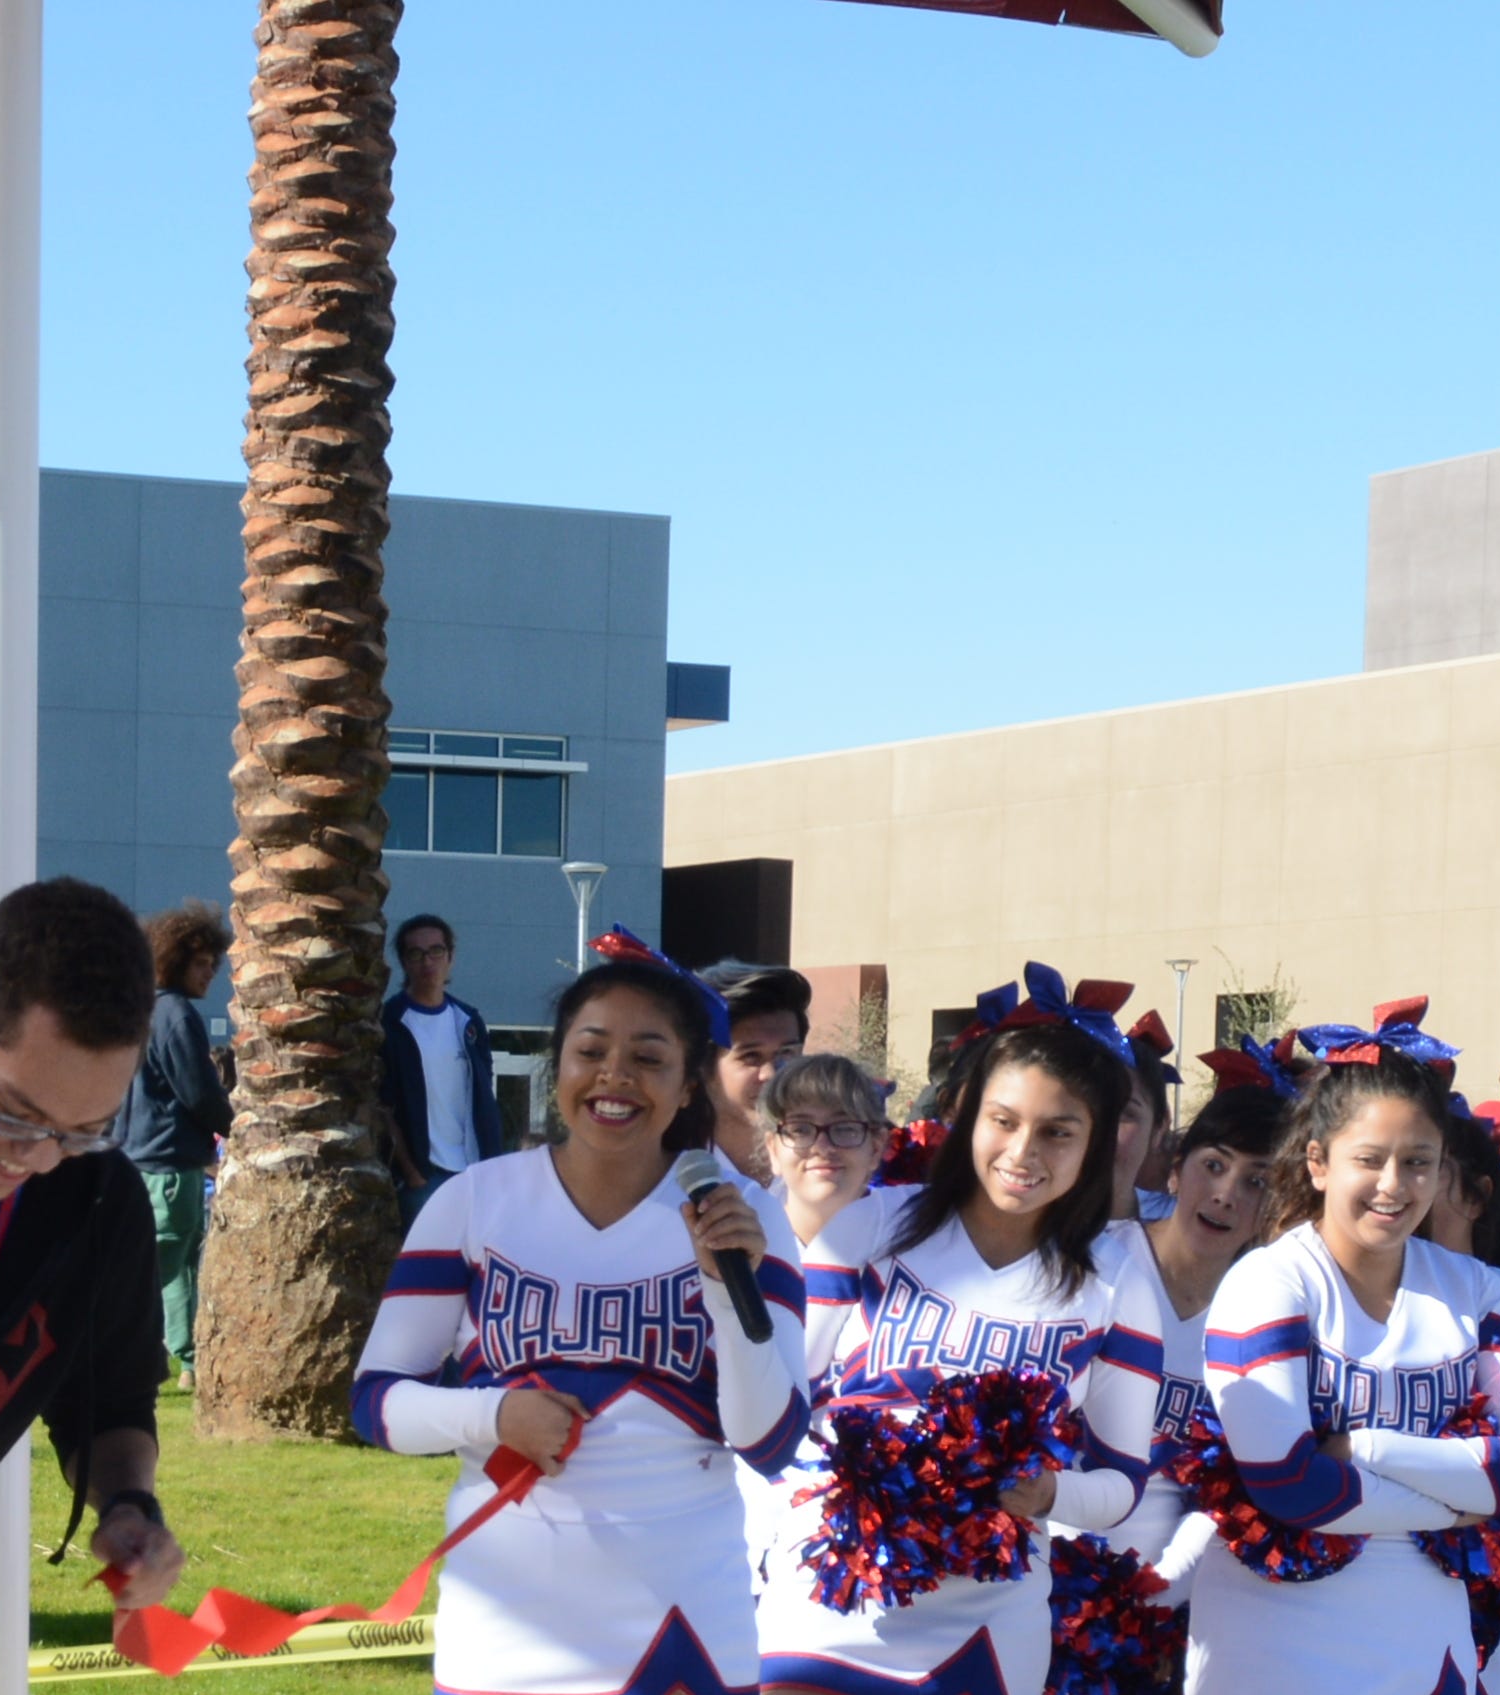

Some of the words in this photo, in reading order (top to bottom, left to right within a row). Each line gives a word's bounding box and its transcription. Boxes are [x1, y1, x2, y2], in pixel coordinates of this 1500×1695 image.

[481, 1246, 706, 1383] RAJAHS
[1308, 1338, 1479, 1438] RAJAH
[348, 1618, 424, 1650] CUIDADO
